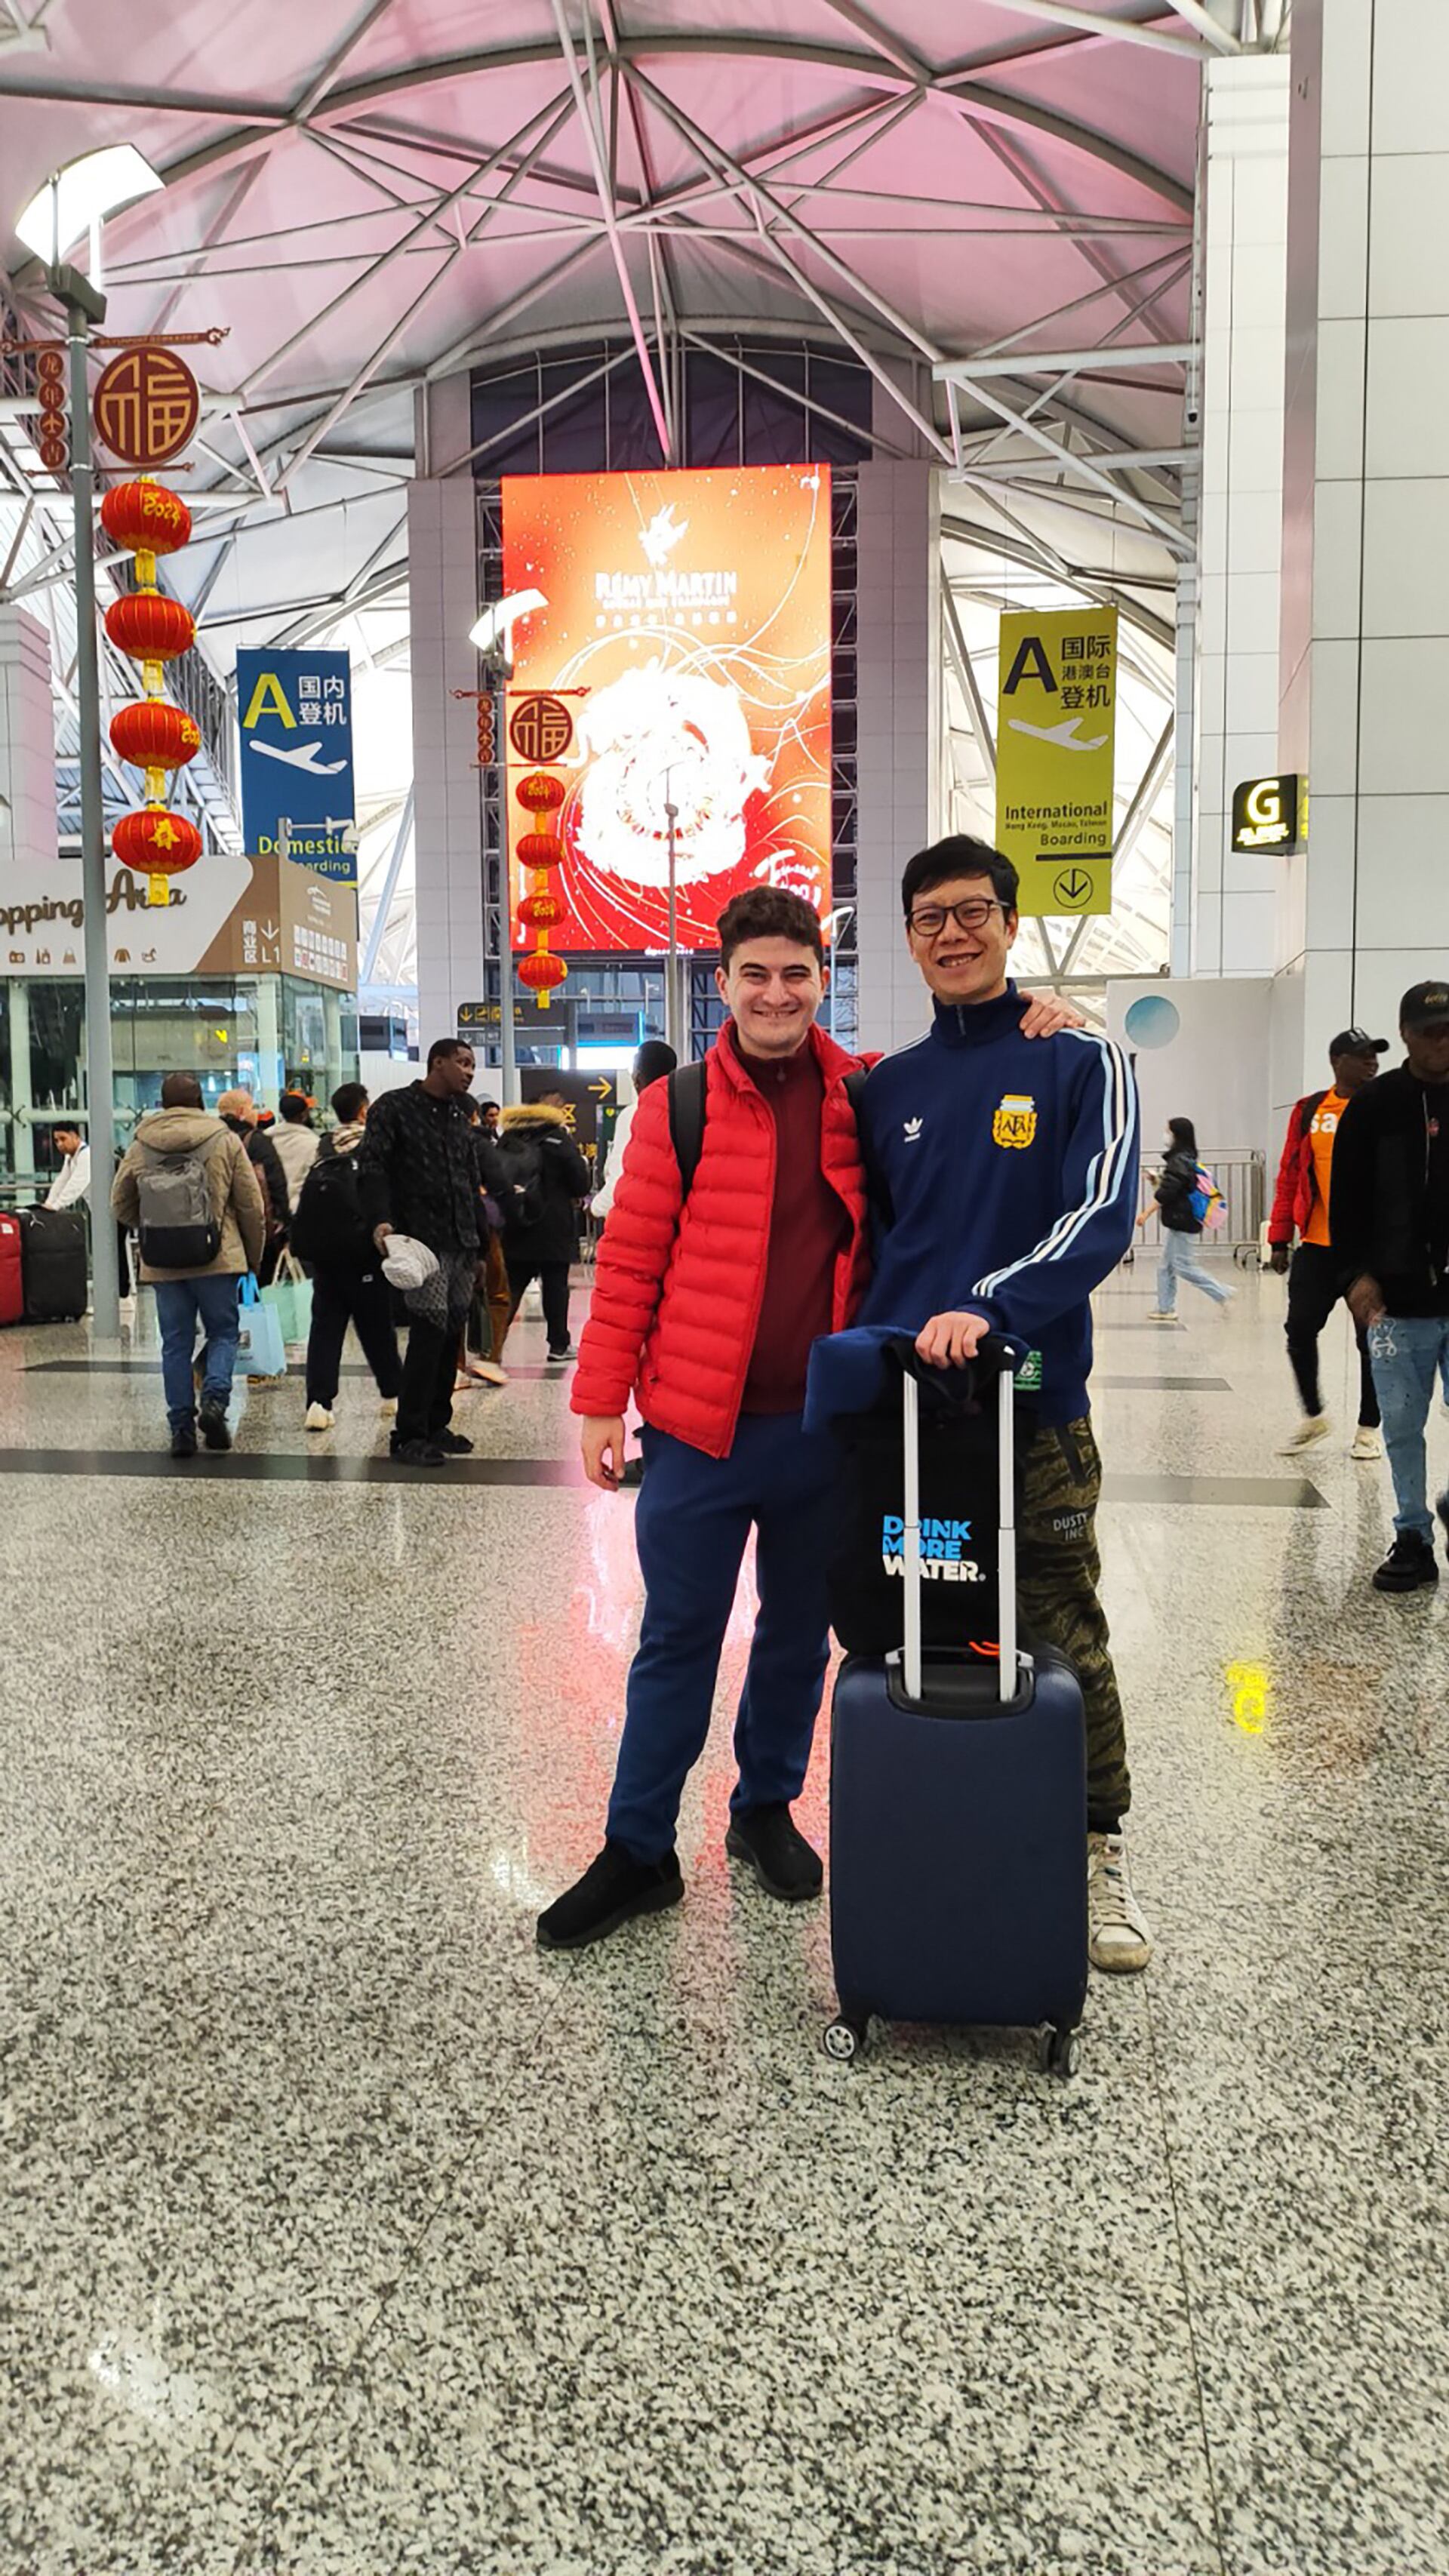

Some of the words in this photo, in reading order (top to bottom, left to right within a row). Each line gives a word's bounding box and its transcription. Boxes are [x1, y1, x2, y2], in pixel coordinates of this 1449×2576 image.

[100, 353, 191, 457] 福
[1061, 635, 1111, 660] 国际
[1002, 637, 1058, 694] A
[1062, 663, 1110, 681] 港澳台
[299, 675, 345, 699] 国内
[1060, 684, 1111, 710] 登机
[242, 673, 297, 728] A
[299, 701, 347, 725] 登机
[514, 700, 568, 759] 福
[1005, 800, 1107, 820] International
[1247, 780, 1280, 825] G
[258, 836, 346, 854] Dmesti
[1040, 833, 1106, 847] Boarding
[105, 868, 187, 913] Ara
[262, 946, 280, 963] L1
[883, 1516, 972, 1540] DINK
